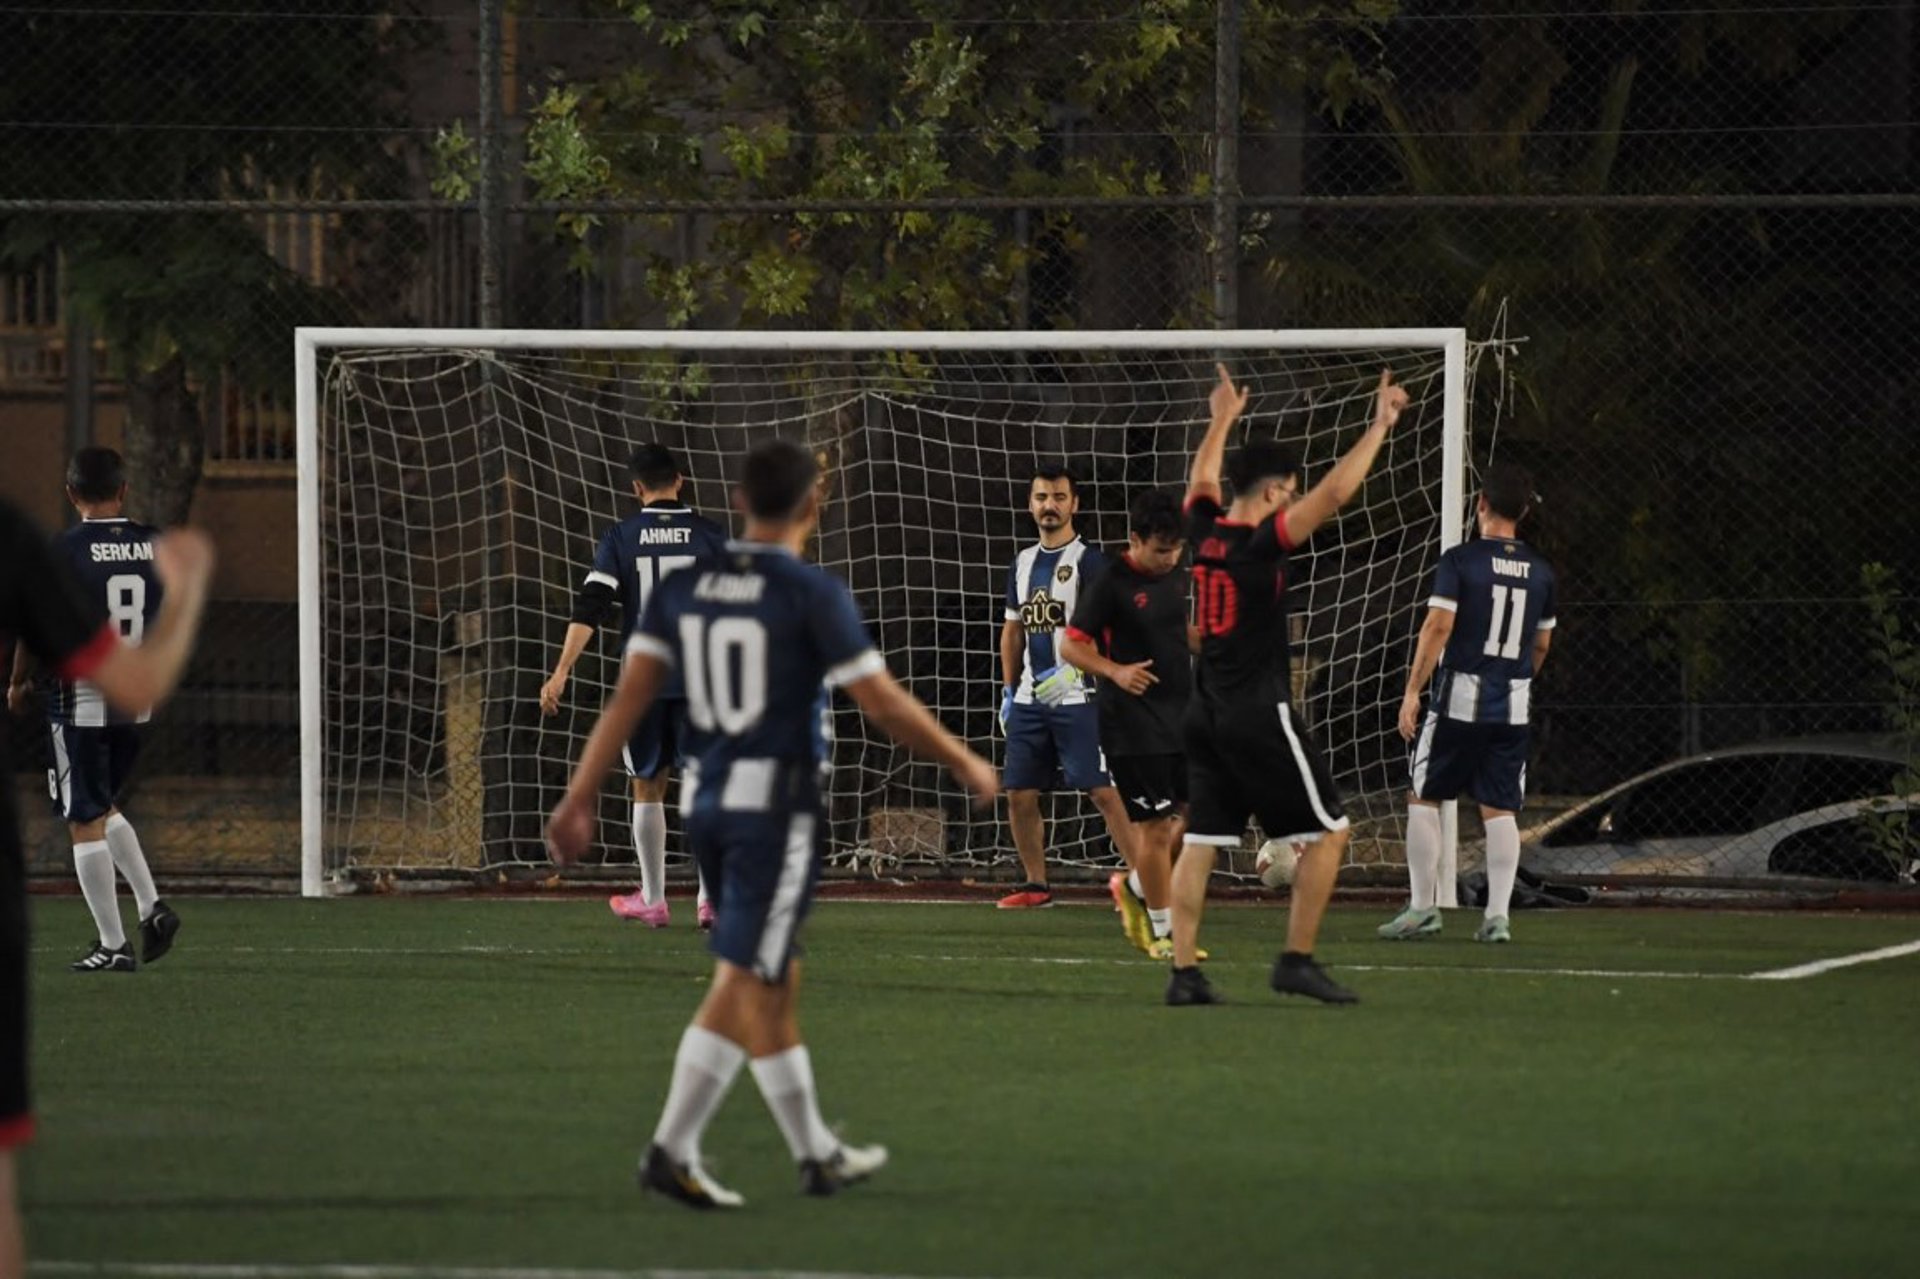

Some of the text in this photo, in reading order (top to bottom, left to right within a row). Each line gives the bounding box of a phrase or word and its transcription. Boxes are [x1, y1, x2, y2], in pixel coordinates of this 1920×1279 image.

[91, 542, 153, 562] SERKAN
[639, 527, 692, 545] AHMET
[1492, 557, 1531, 579] UMUT
[106, 574, 145, 649] 8
[1191, 564, 1237, 637] 10
[1483, 584, 1527, 660] 11
[678, 613, 768, 734] 10
